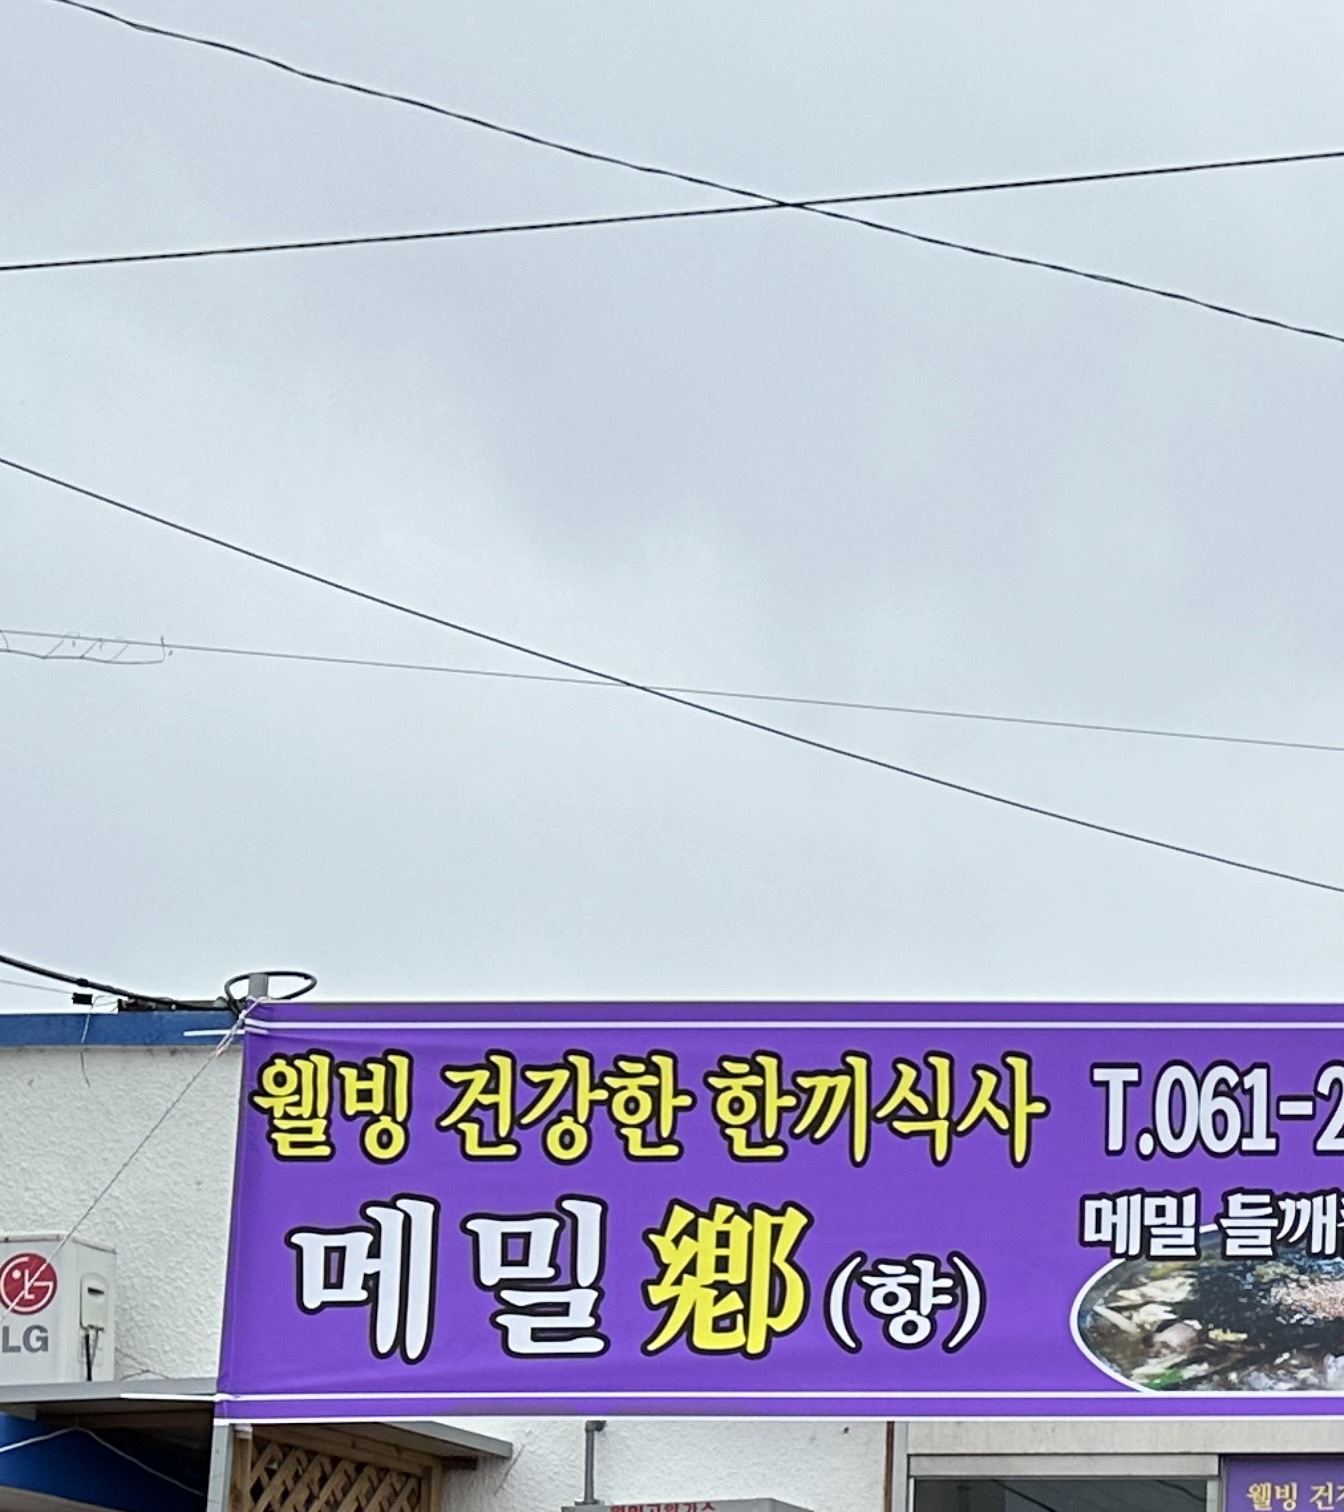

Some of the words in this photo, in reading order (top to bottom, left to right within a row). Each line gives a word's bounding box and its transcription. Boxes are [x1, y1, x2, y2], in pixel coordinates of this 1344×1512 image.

[253, 1053, 412, 1162] 웰빙
[440, 1054, 695, 1163] 건강한
[707, 1054, 1049, 1165] 한끼식사
[1082, 1190, 1199, 1257] 메밀
[2, 1325, 48, 1353] LG
[1247, 1482, 1298, 1511] 웰빙
